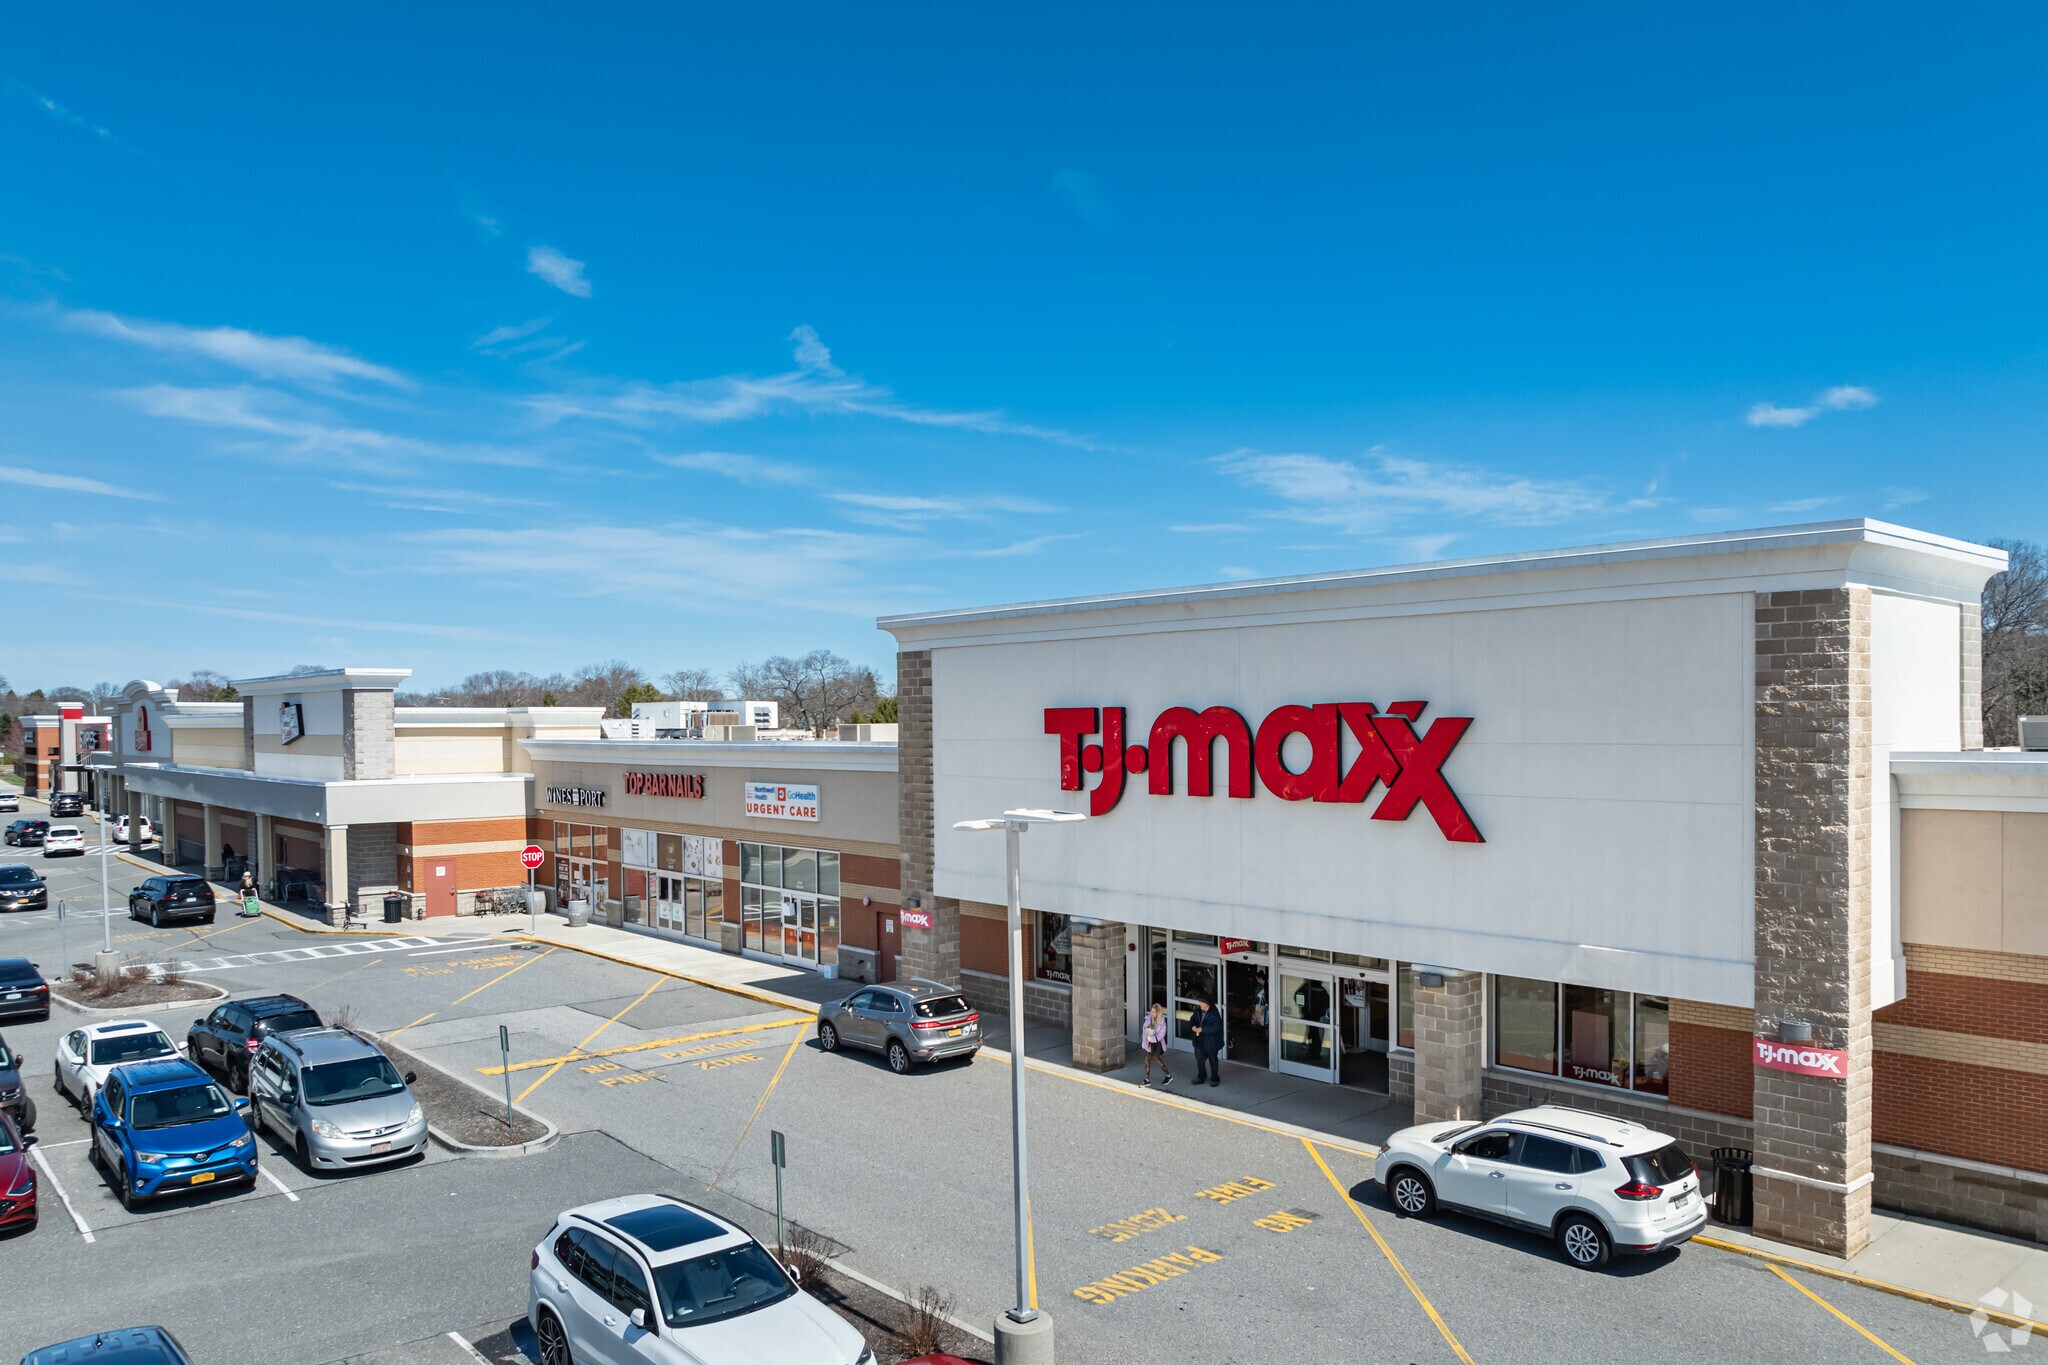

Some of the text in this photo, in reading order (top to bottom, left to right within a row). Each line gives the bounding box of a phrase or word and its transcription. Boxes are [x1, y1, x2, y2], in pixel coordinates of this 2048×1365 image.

[623, 772, 703, 798] TOP BAR NAILS
[546, 787, 603, 807] WINES PORT
[787, 790, 816, 801] GoHealth
[746, 803, 816, 818] URGENT CARE
[522, 852, 543, 862] STOP
[579, 1038, 761, 1074] NO PARKING
[692, 1053, 765, 1070] ZONE
[1073, 1210, 1313, 1305] NO PARKING
